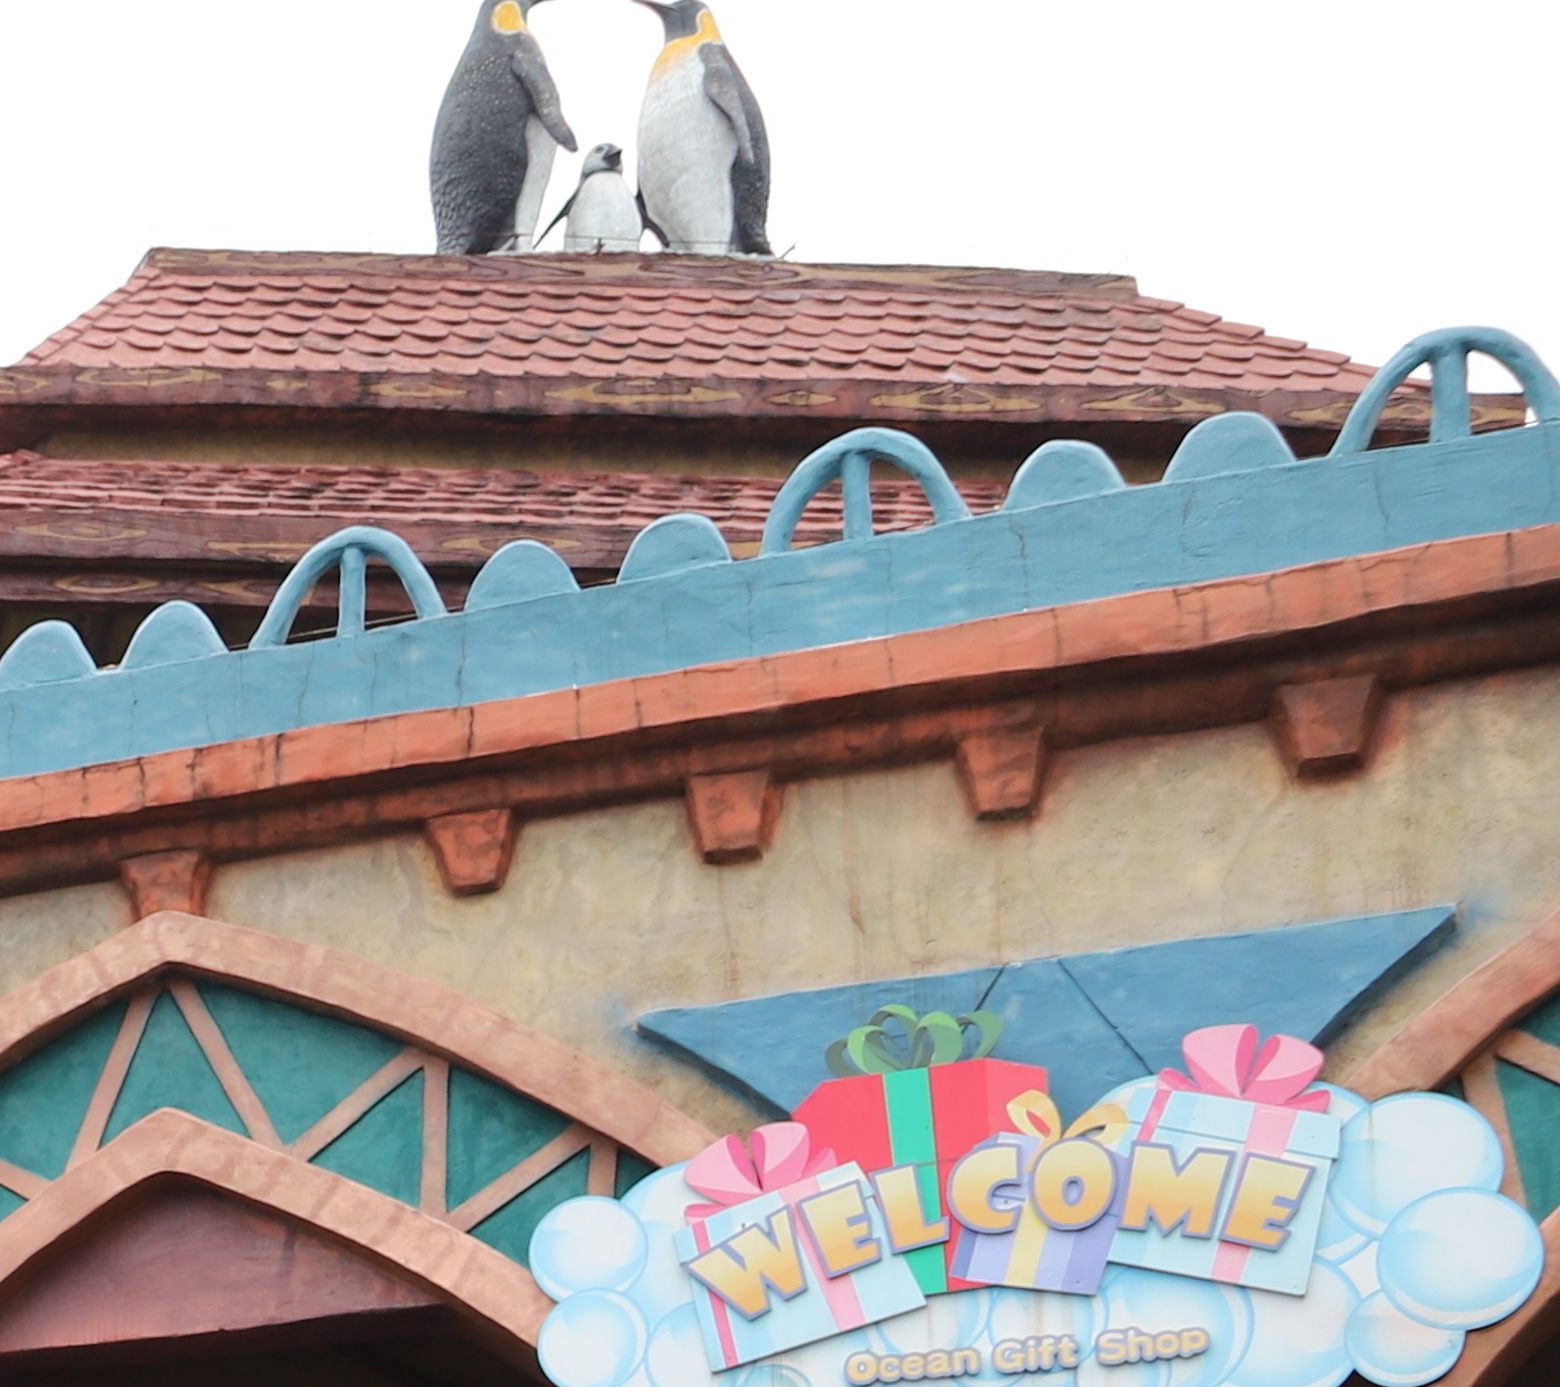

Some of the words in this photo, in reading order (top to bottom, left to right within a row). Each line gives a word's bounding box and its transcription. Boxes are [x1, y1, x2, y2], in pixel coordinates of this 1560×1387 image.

[682, 1138, 1316, 1320] WELCOME
[844, 1341, 980, 1386] Ocean
[993, 1333, 1080, 1373] Gift
[1097, 1325, 1210, 1365] Shop
